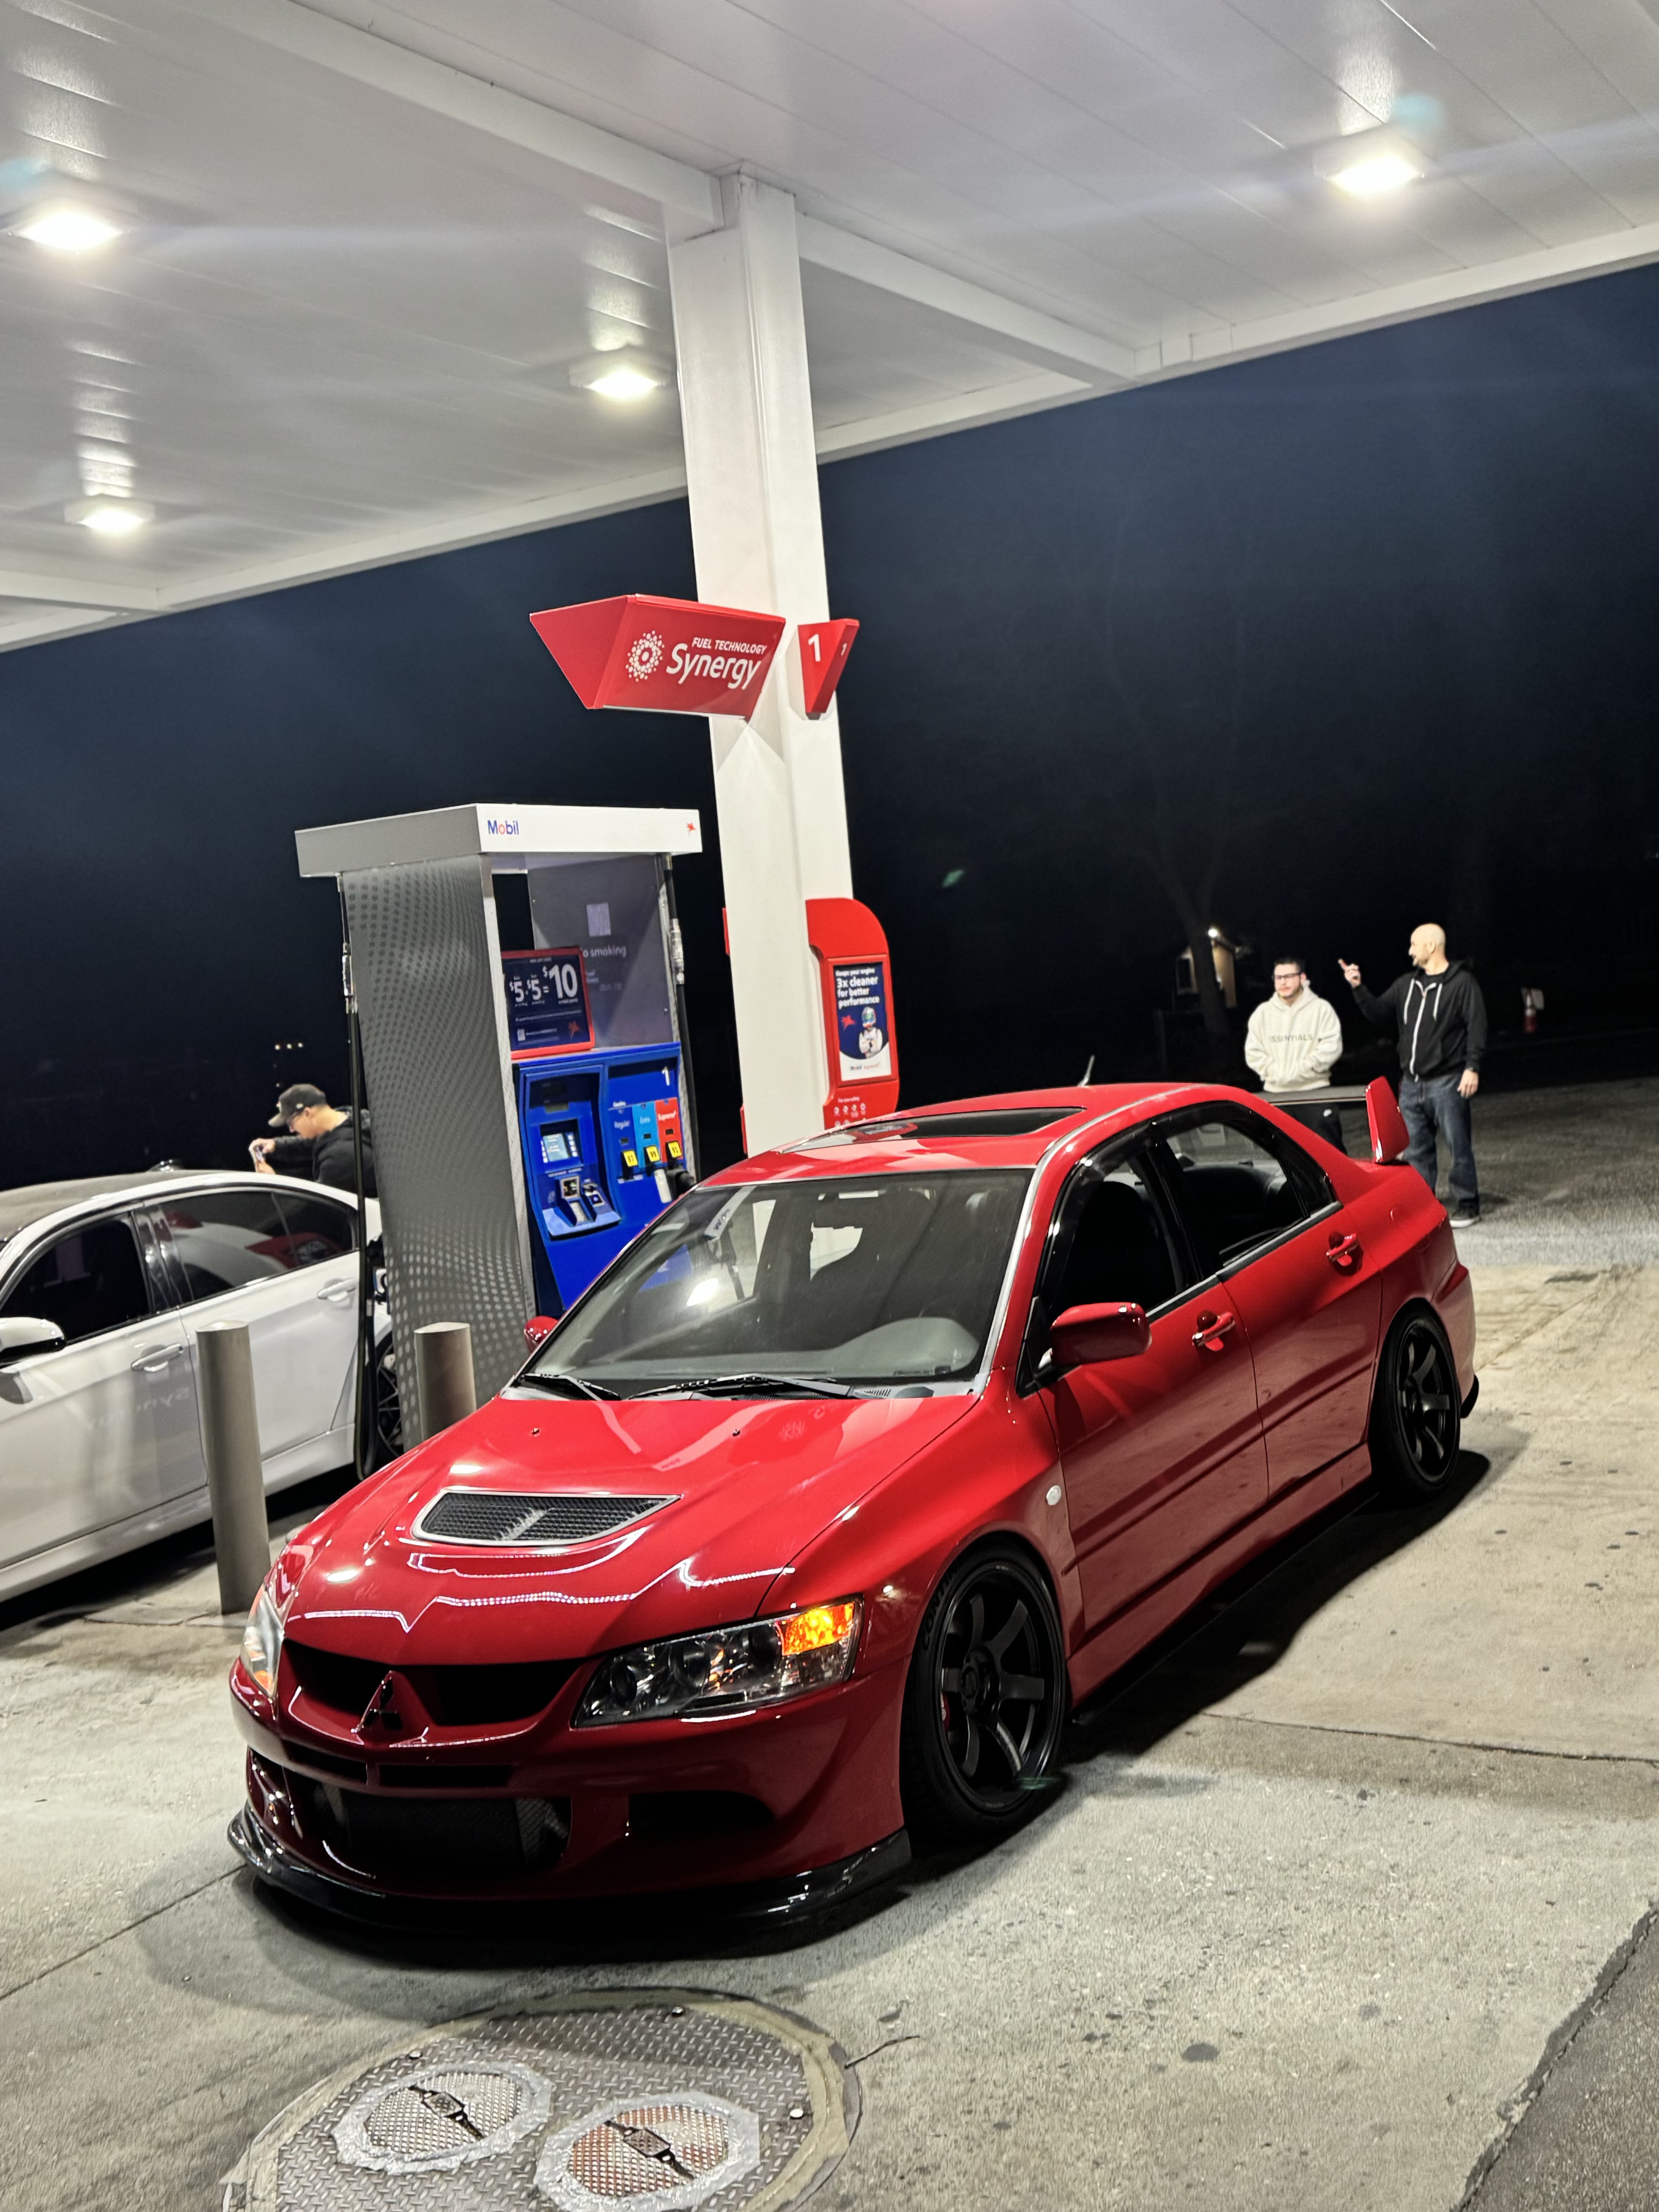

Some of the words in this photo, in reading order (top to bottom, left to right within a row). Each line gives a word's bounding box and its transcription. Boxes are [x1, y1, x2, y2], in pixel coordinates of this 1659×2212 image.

[692, 637, 712, 649] FUEL
[715, 640, 767, 655] TECHNOLOGY
[808, 634, 821, 662] 1
[841, 643, 847, 656] 1
[666, 643, 762, 689] Synergy
[487, 820, 519, 835] Mobil
[582, 949, 589, 957] o
[590, 944, 627, 958] smoking
[836, 978, 848, 988] 3x
[849, 976, 878, 987] cleaner
[837, 989, 848, 998] for
[848, 988, 869, 997] better
[838, 996, 879, 1010] performance
[662, 1066, 670, 1085] 1
